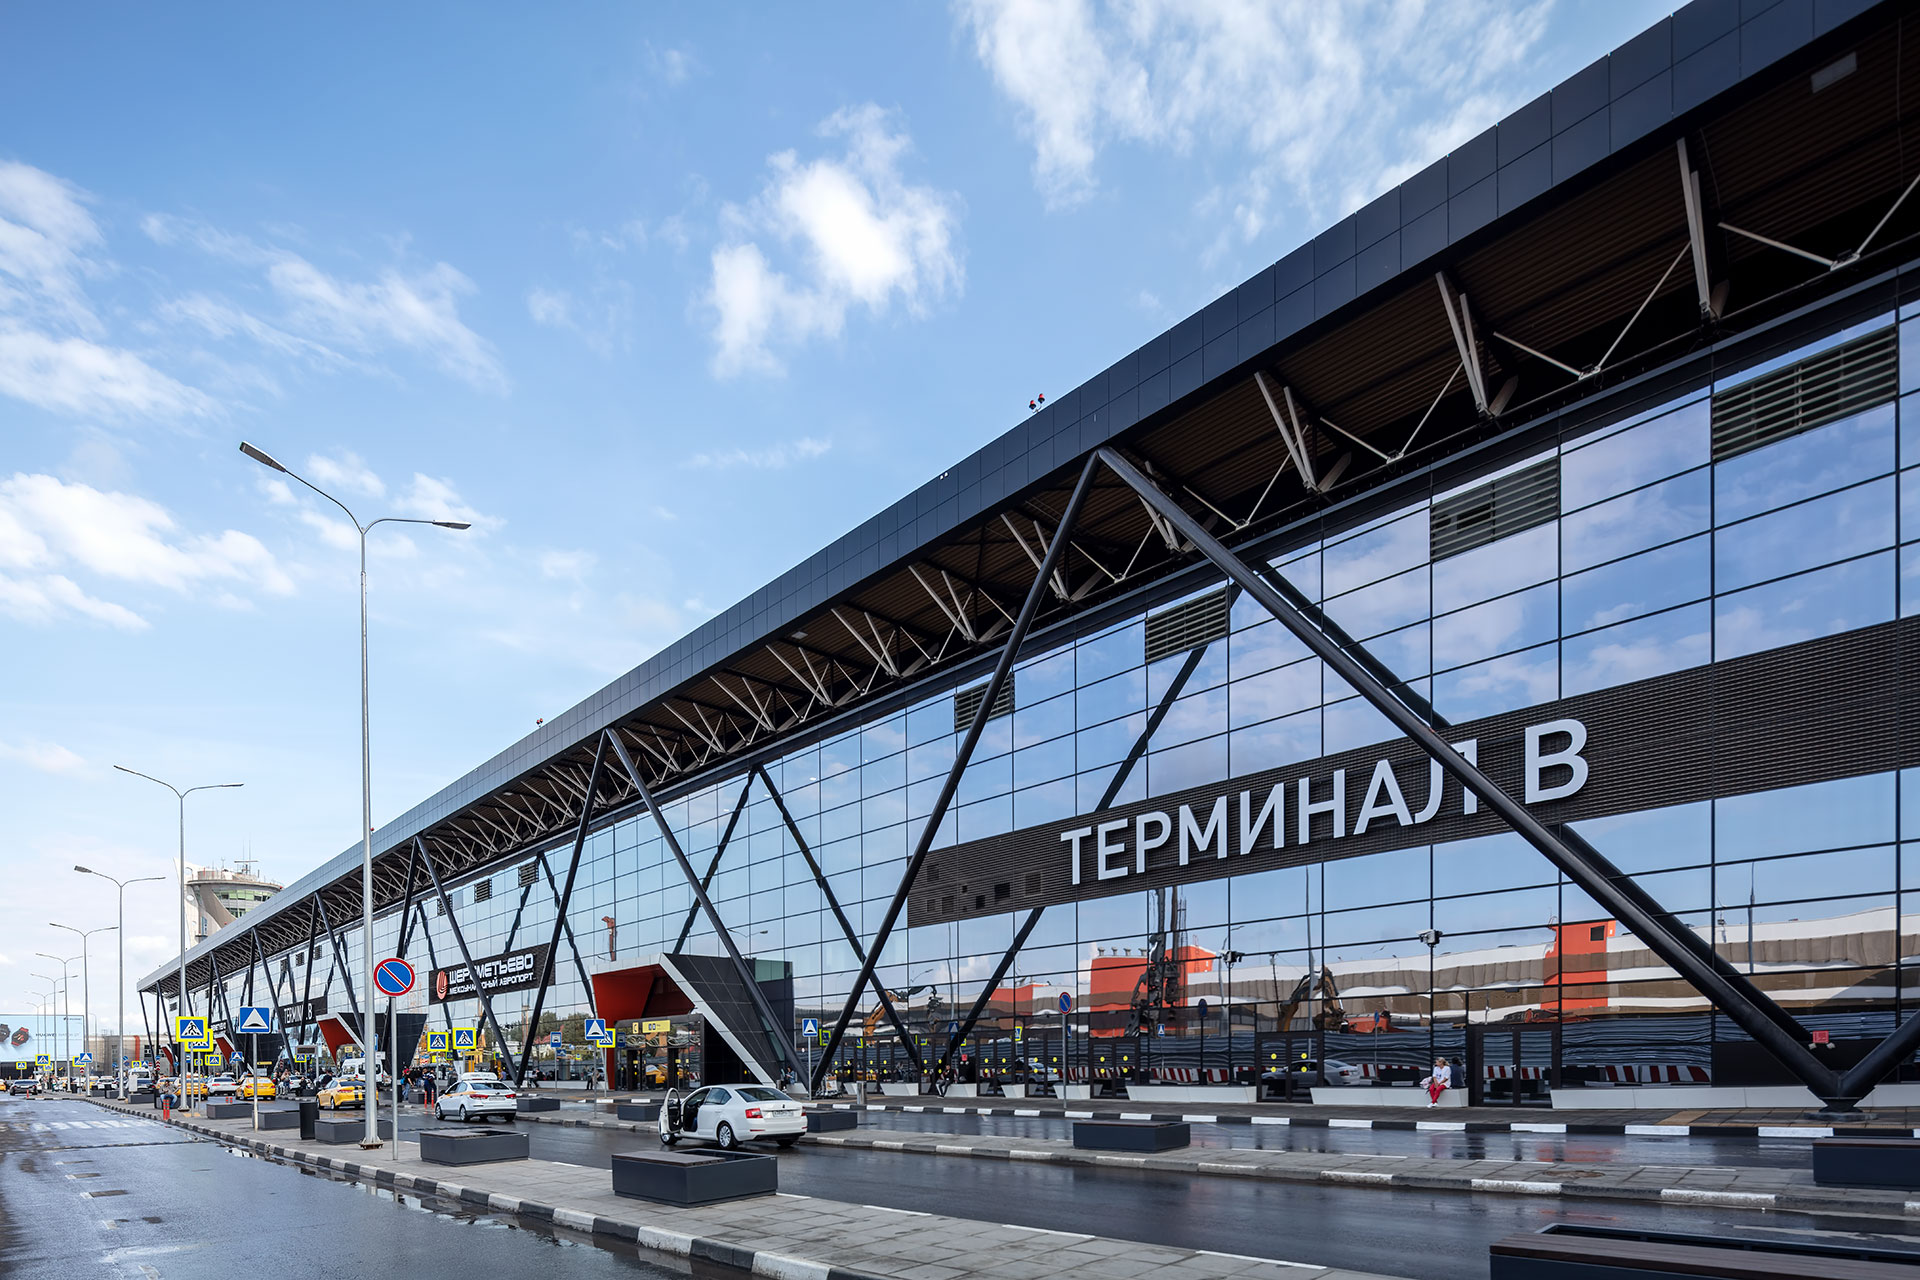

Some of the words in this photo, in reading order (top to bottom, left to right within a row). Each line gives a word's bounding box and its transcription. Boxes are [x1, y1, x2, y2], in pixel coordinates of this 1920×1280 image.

[1060, 738, 1478, 885] ТЕРМИНАЛ
[449, 953, 534, 985] ШЕРМЕТЬЕВО
[499, 973, 534, 986] АЭРОПОРТ
